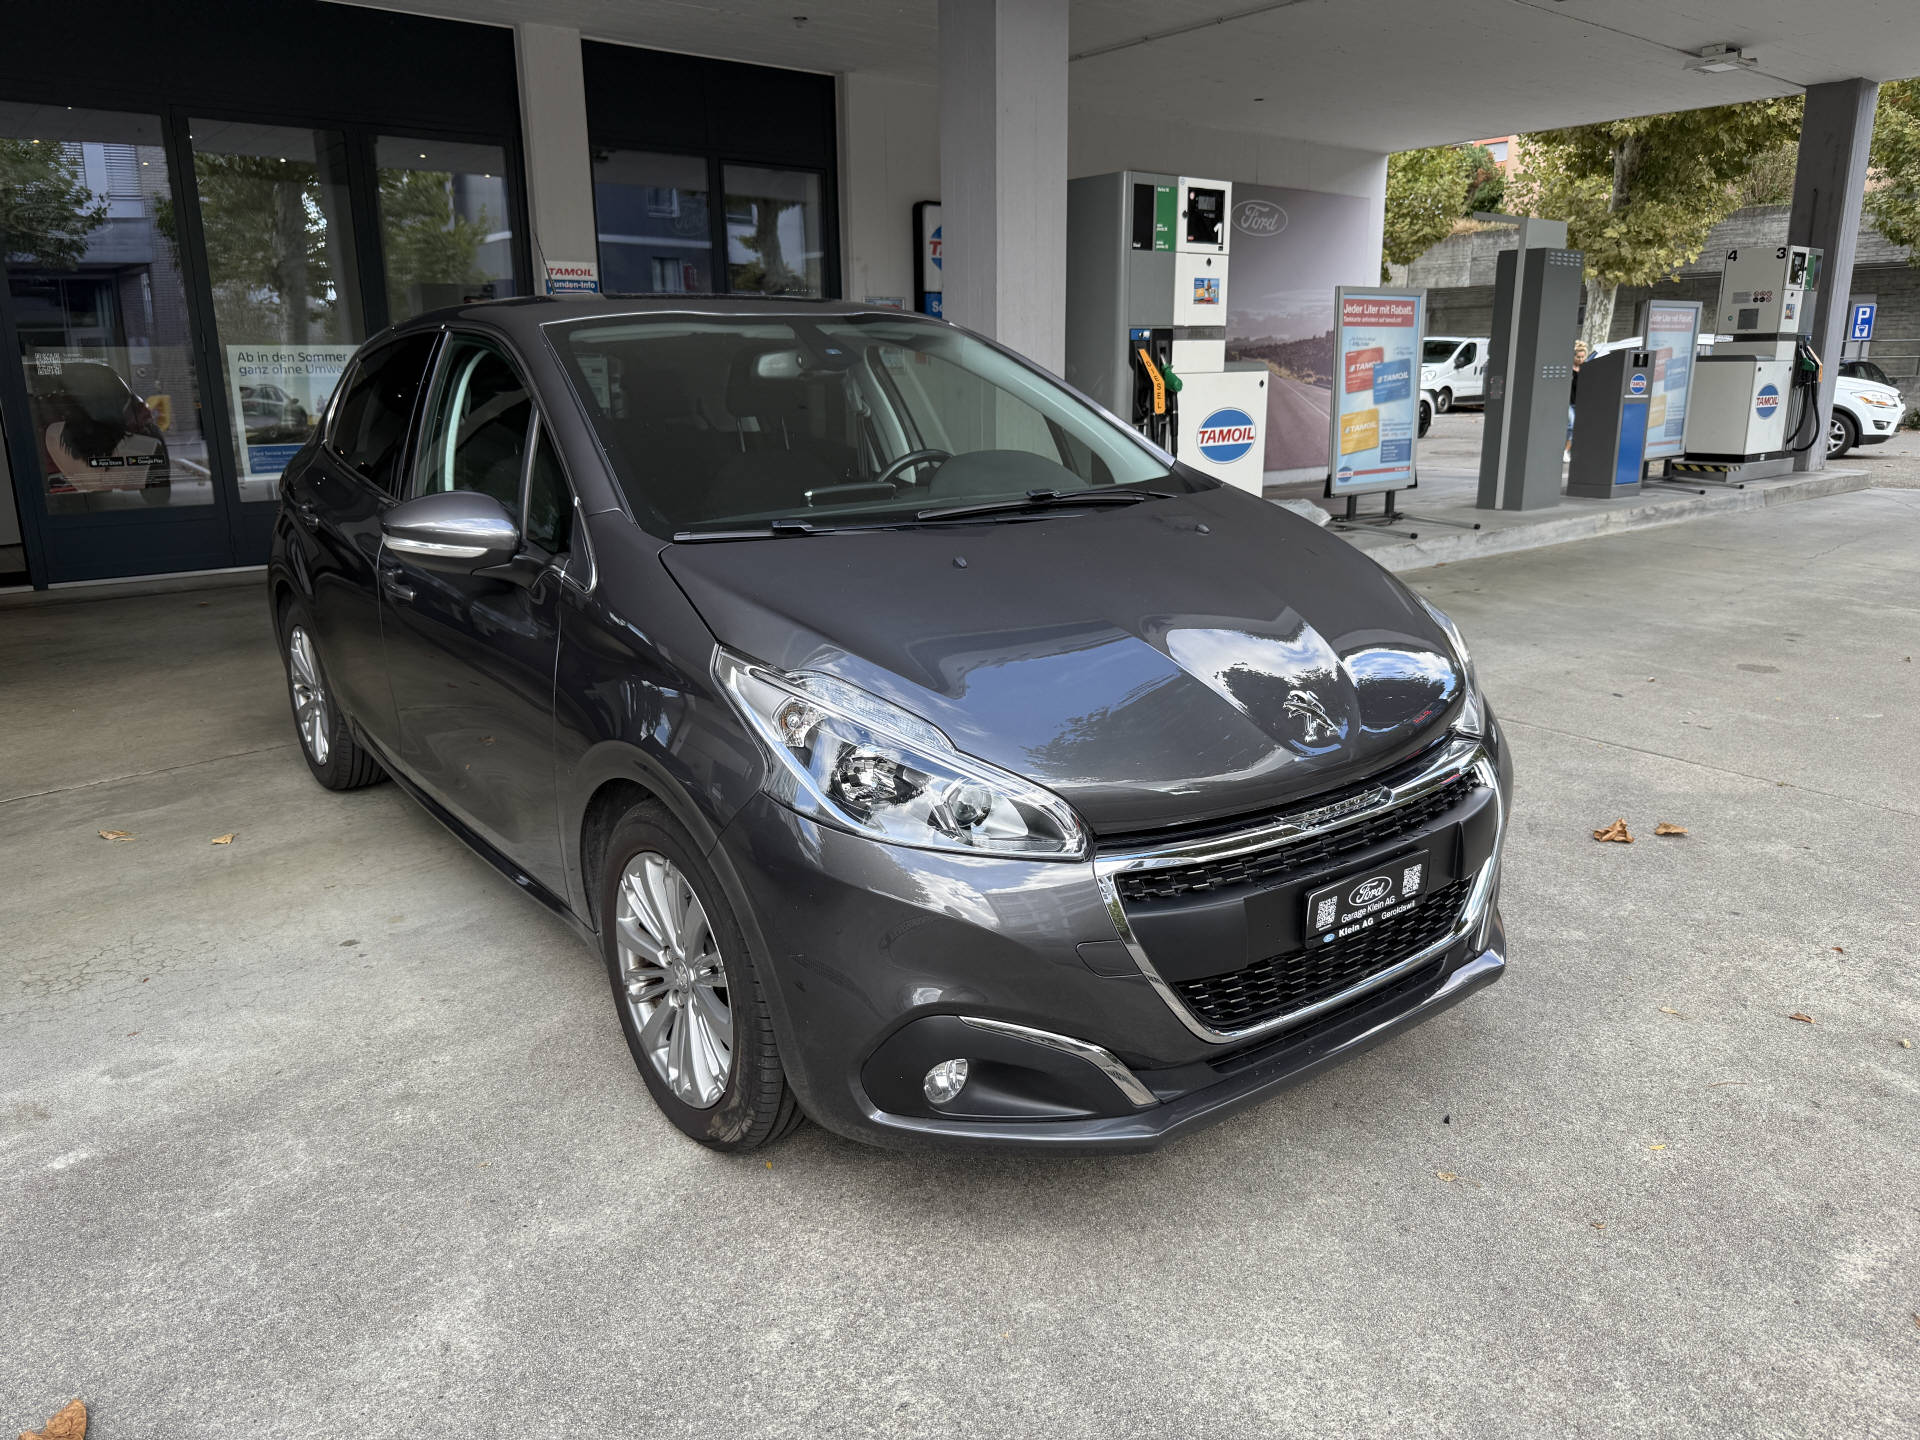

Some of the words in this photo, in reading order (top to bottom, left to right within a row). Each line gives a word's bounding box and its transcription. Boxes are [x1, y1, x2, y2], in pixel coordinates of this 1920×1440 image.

[1241, 204, 1278, 231] Ford
[1213, 222, 1223, 244] 1
[929, 241, 942, 256] T
[1727, 250, 1738, 262] 4
[1776, 247, 1787, 260] 3
[549, 267, 593, 277] TAMOIL
[1344, 304, 1362, 314] Jeder
[1364, 304, 1379, 315] Liter
[1379, 304, 1390, 315] mit
[1857, 307, 1870, 325] P
[237, 351, 254, 362] Ab
[257, 352, 268, 362] in
[271, 352, 296, 362] den
[298, 351, 348, 362] Sommer
[239, 365, 269, 377] ganz
[271, 364, 304, 375] ohne
[1145, 360, 1162, 410] DIESEL
[1756, 395, 1779, 407] TAMOIL
[1199, 427, 1255, 445] TAMOIL
[1355, 880, 1385, 903] Ford
[1341, 908, 1367, 923] Garage
[1367, 899, 1385, 914] Klein
[1385, 895, 1396, 909] AG
[1338, 924, 1360, 937] Klein
[1362, 917, 1374, 929] AG
